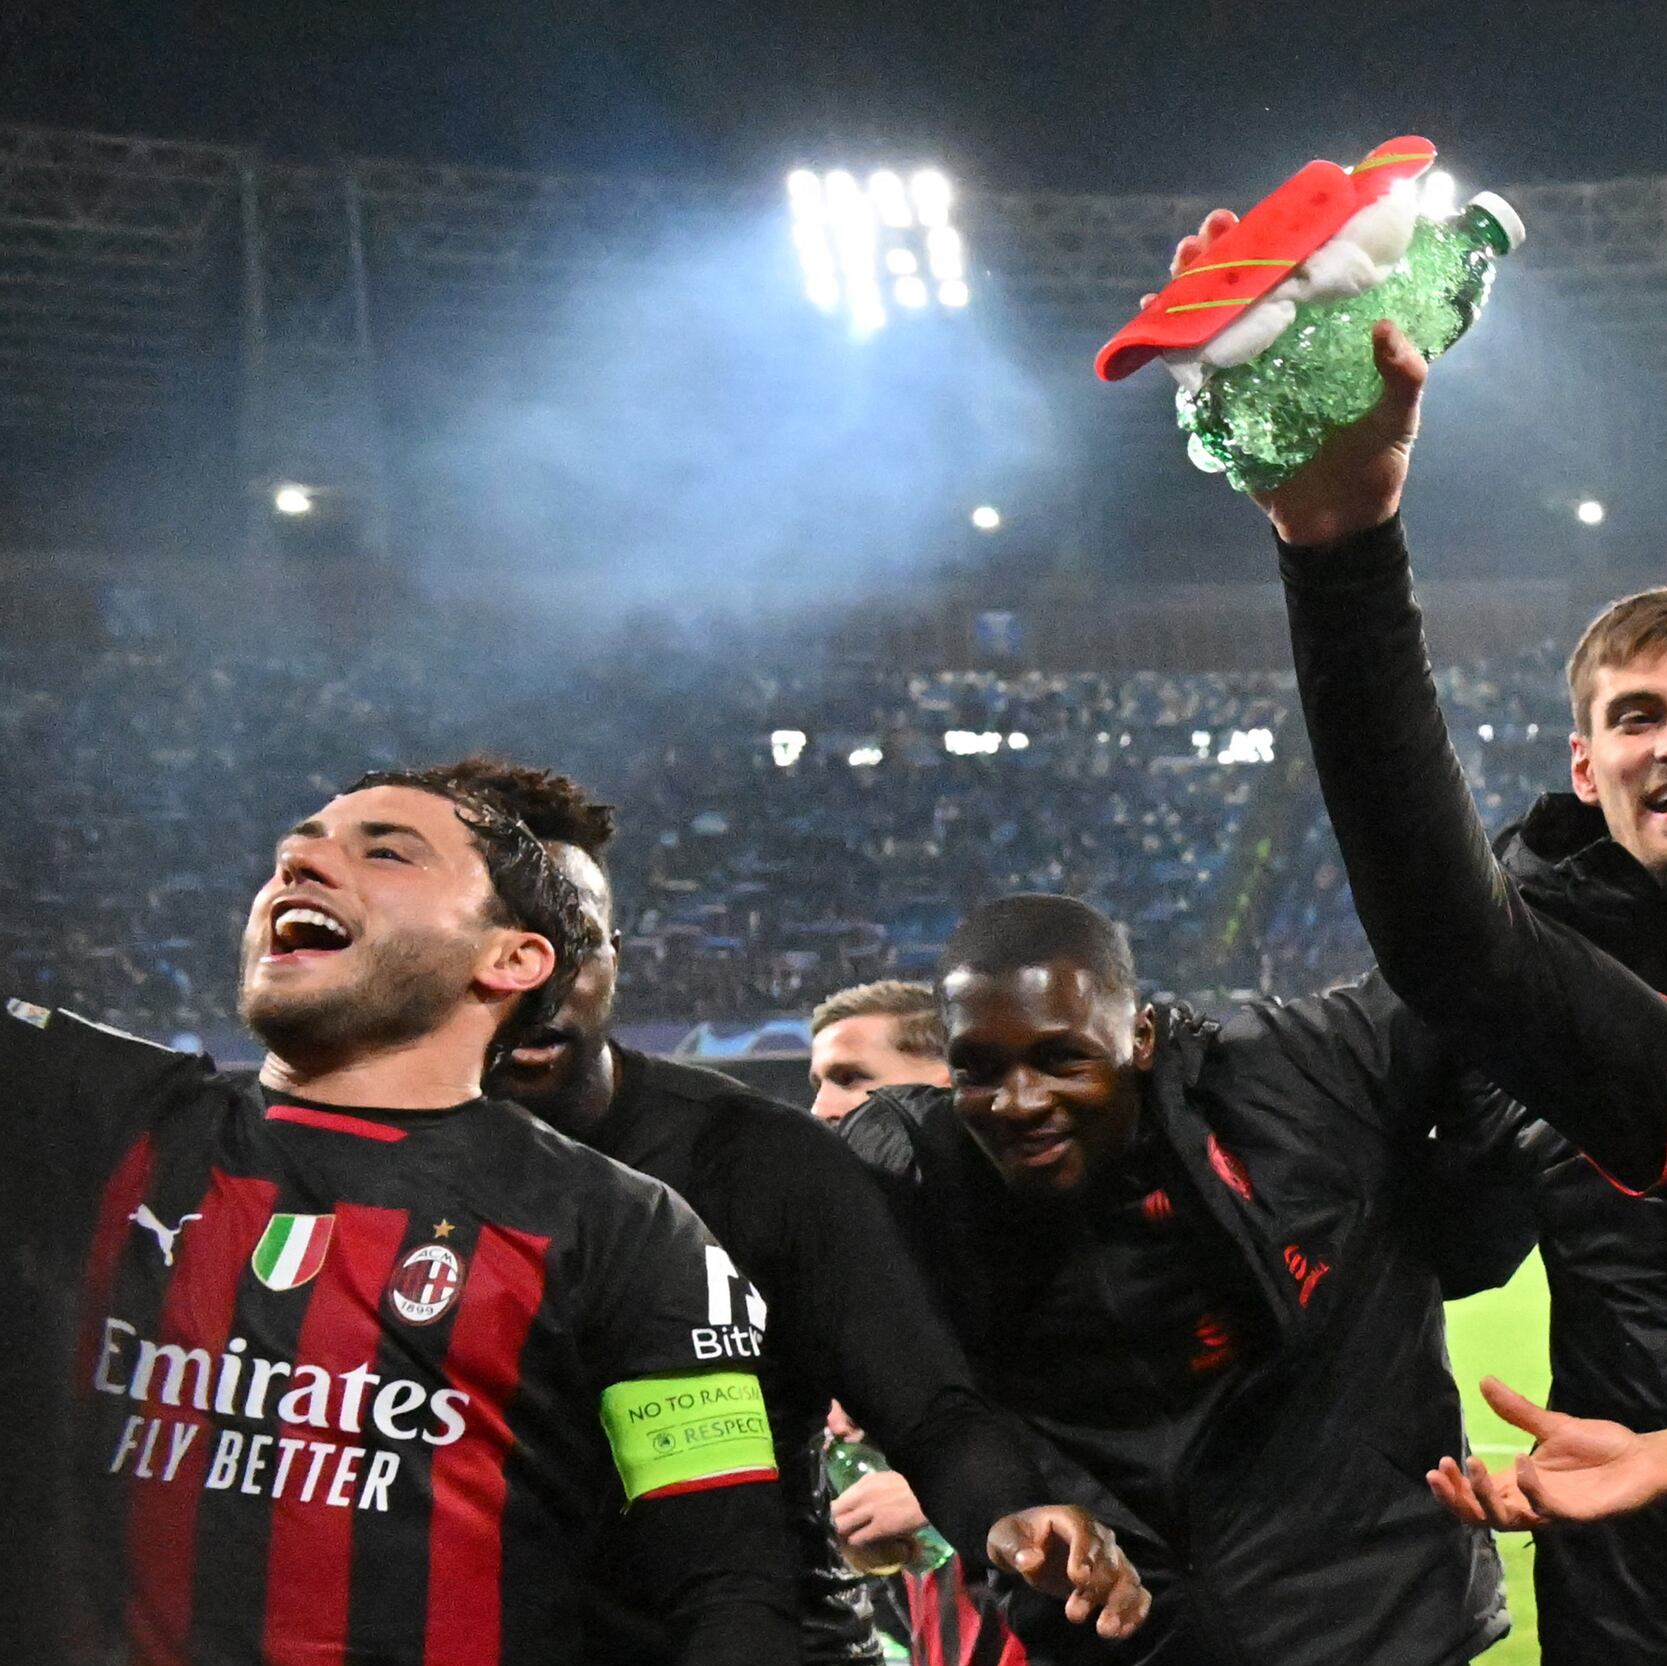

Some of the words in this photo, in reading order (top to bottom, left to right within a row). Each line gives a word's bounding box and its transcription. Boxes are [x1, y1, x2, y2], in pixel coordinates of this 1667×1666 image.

[416, 1249, 453, 1264] ACM
[401, 1301, 434, 1316] 1899
[96, 1317, 470, 1446] Emirates
[628, 1403, 661, 1424] NO
[665, 1393, 695, 1412] TO
[684, 1417, 766, 1445] RESPECT
[109, 1415, 198, 1482] FLY
[205, 1429, 401, 1512] BETTER
